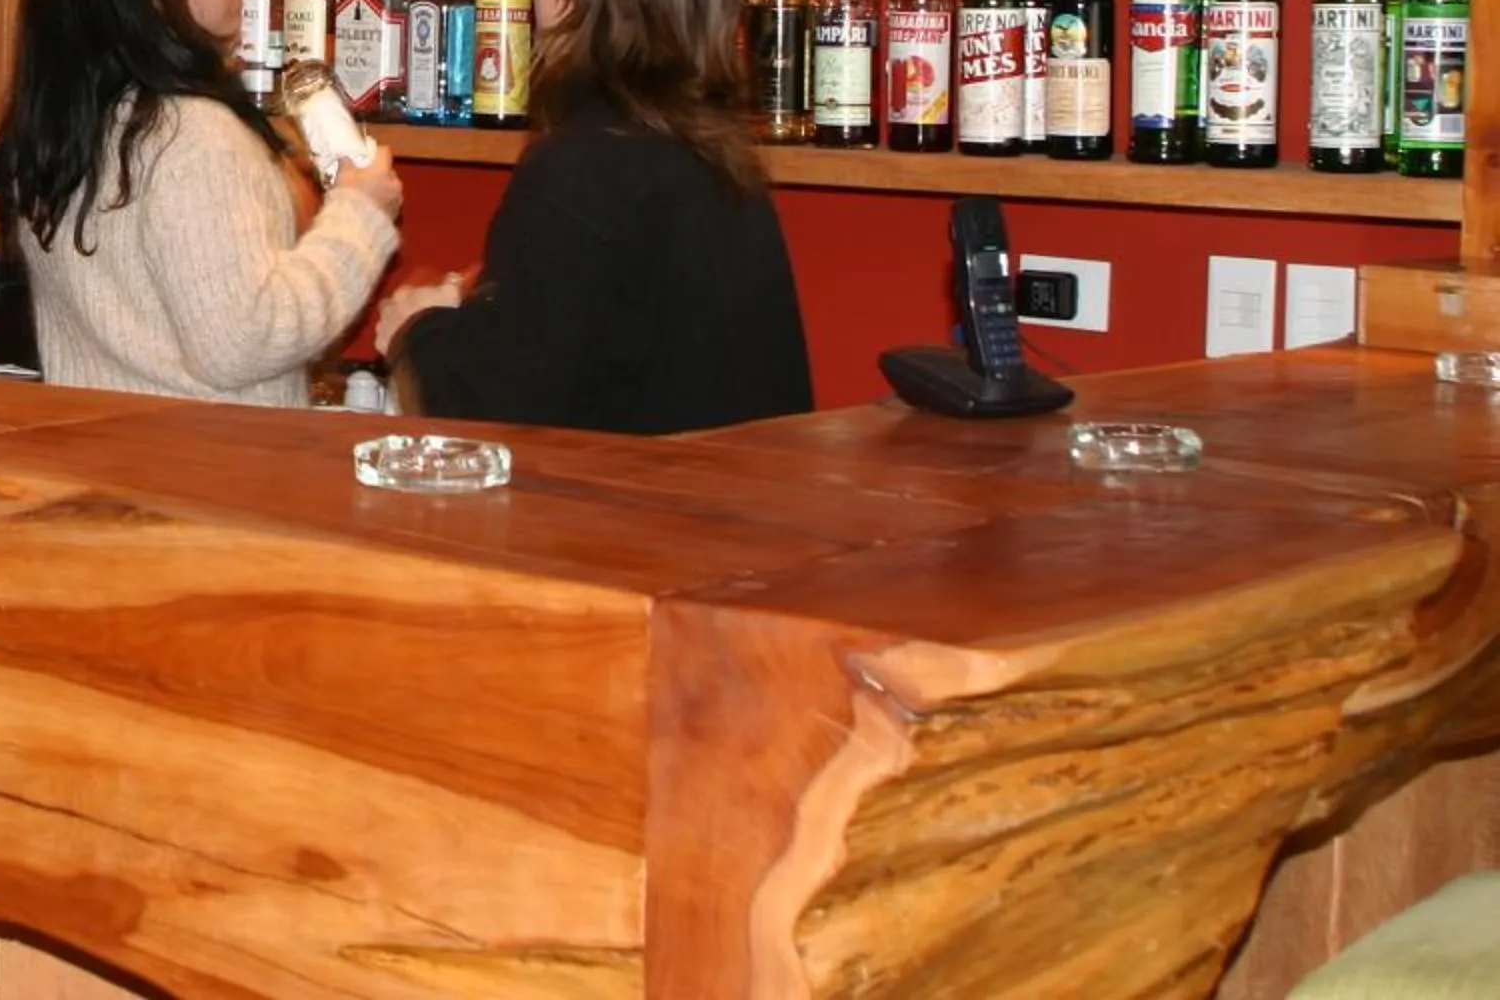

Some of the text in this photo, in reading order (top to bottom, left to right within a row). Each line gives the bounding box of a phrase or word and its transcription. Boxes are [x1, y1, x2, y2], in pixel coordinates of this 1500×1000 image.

[963, 13, 1018, 33] RPANO
[1130, 17, 1188, 37] ancia
[1314, 9, 1375, 28] ARTINI
[815, 25, 869, 43] AMPARI
[963, 52, 1017, 79] MES
